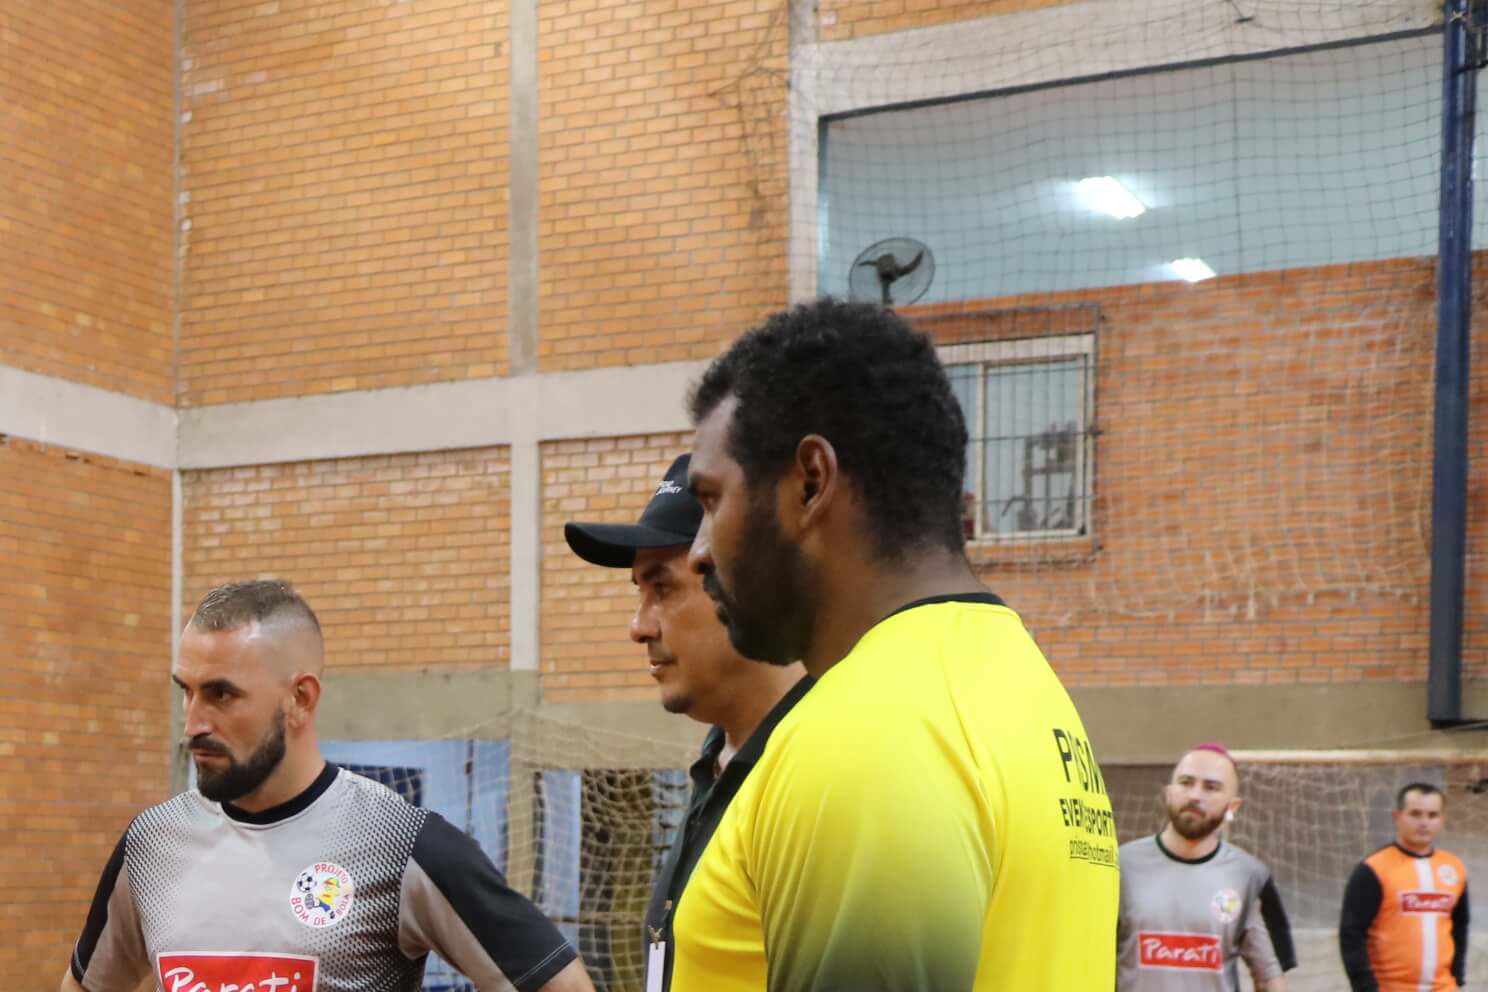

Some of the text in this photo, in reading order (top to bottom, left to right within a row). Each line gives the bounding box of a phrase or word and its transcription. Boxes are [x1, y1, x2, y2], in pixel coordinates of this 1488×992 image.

[291, 896, 310, 922] BOM
[313, 916, 327, 926] DE
[1141, 937, 1222, 964] Parati
